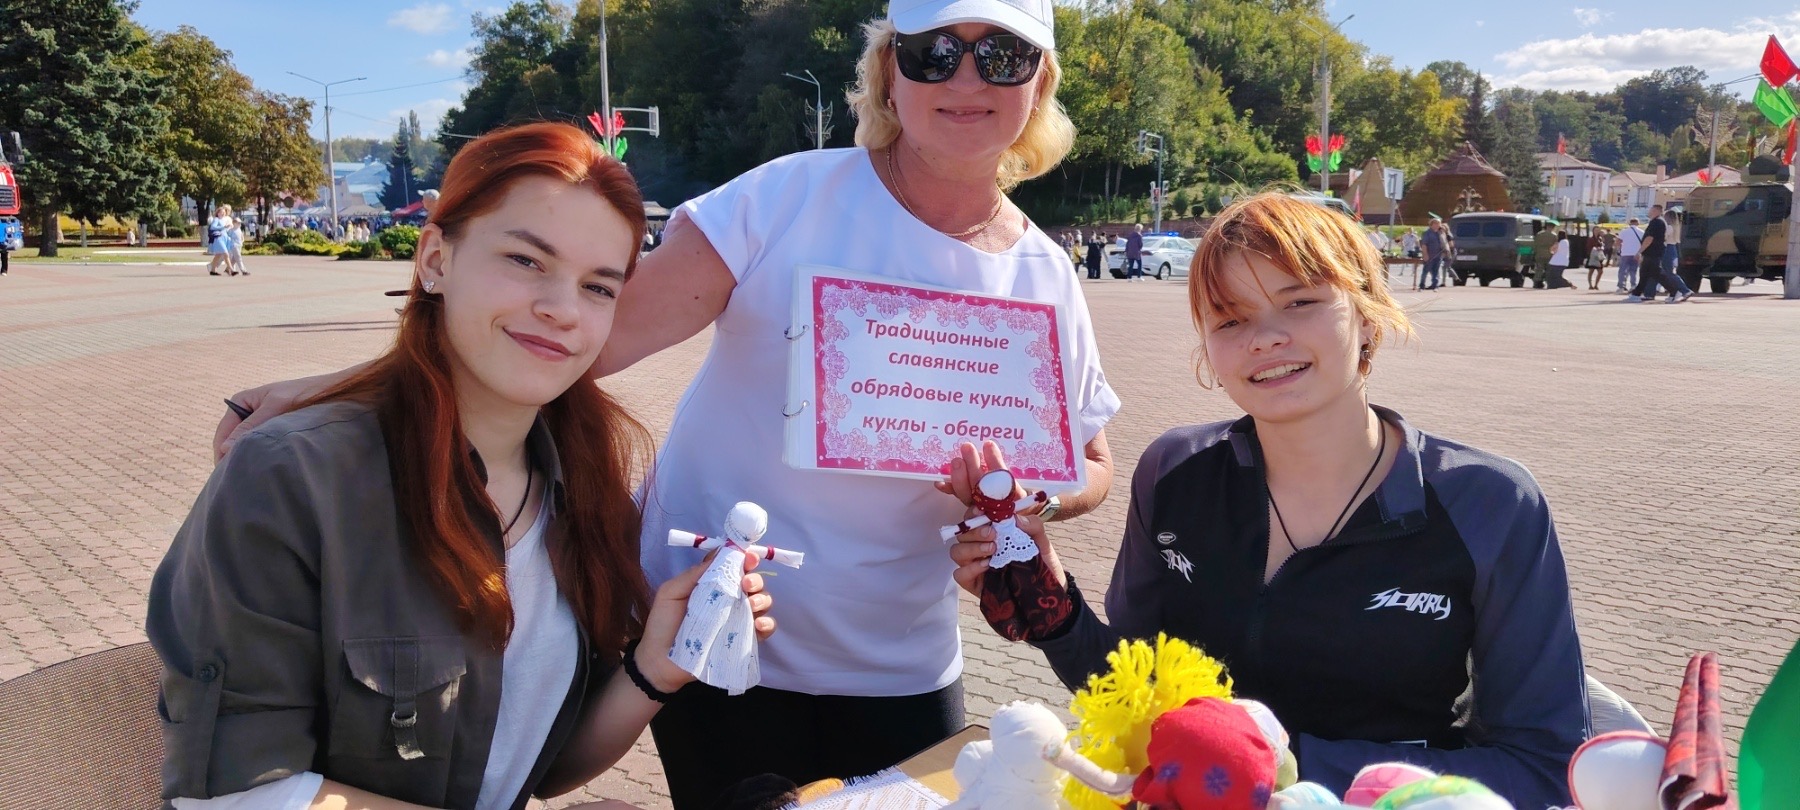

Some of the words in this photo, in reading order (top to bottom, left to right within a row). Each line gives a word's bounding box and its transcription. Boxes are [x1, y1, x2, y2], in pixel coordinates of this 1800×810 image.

[865, 318, 1010, 350] Традиционные
[888, 352, 1000, 375] славянские
[851, 378, 964, 404] обрядовые
[969, 392, 1035, 412] куклы,
[862, 413, 926, 433] куклы
[944, 420, 1025, 441] обереги
[1364, 587, 1451, 620] SORRY
